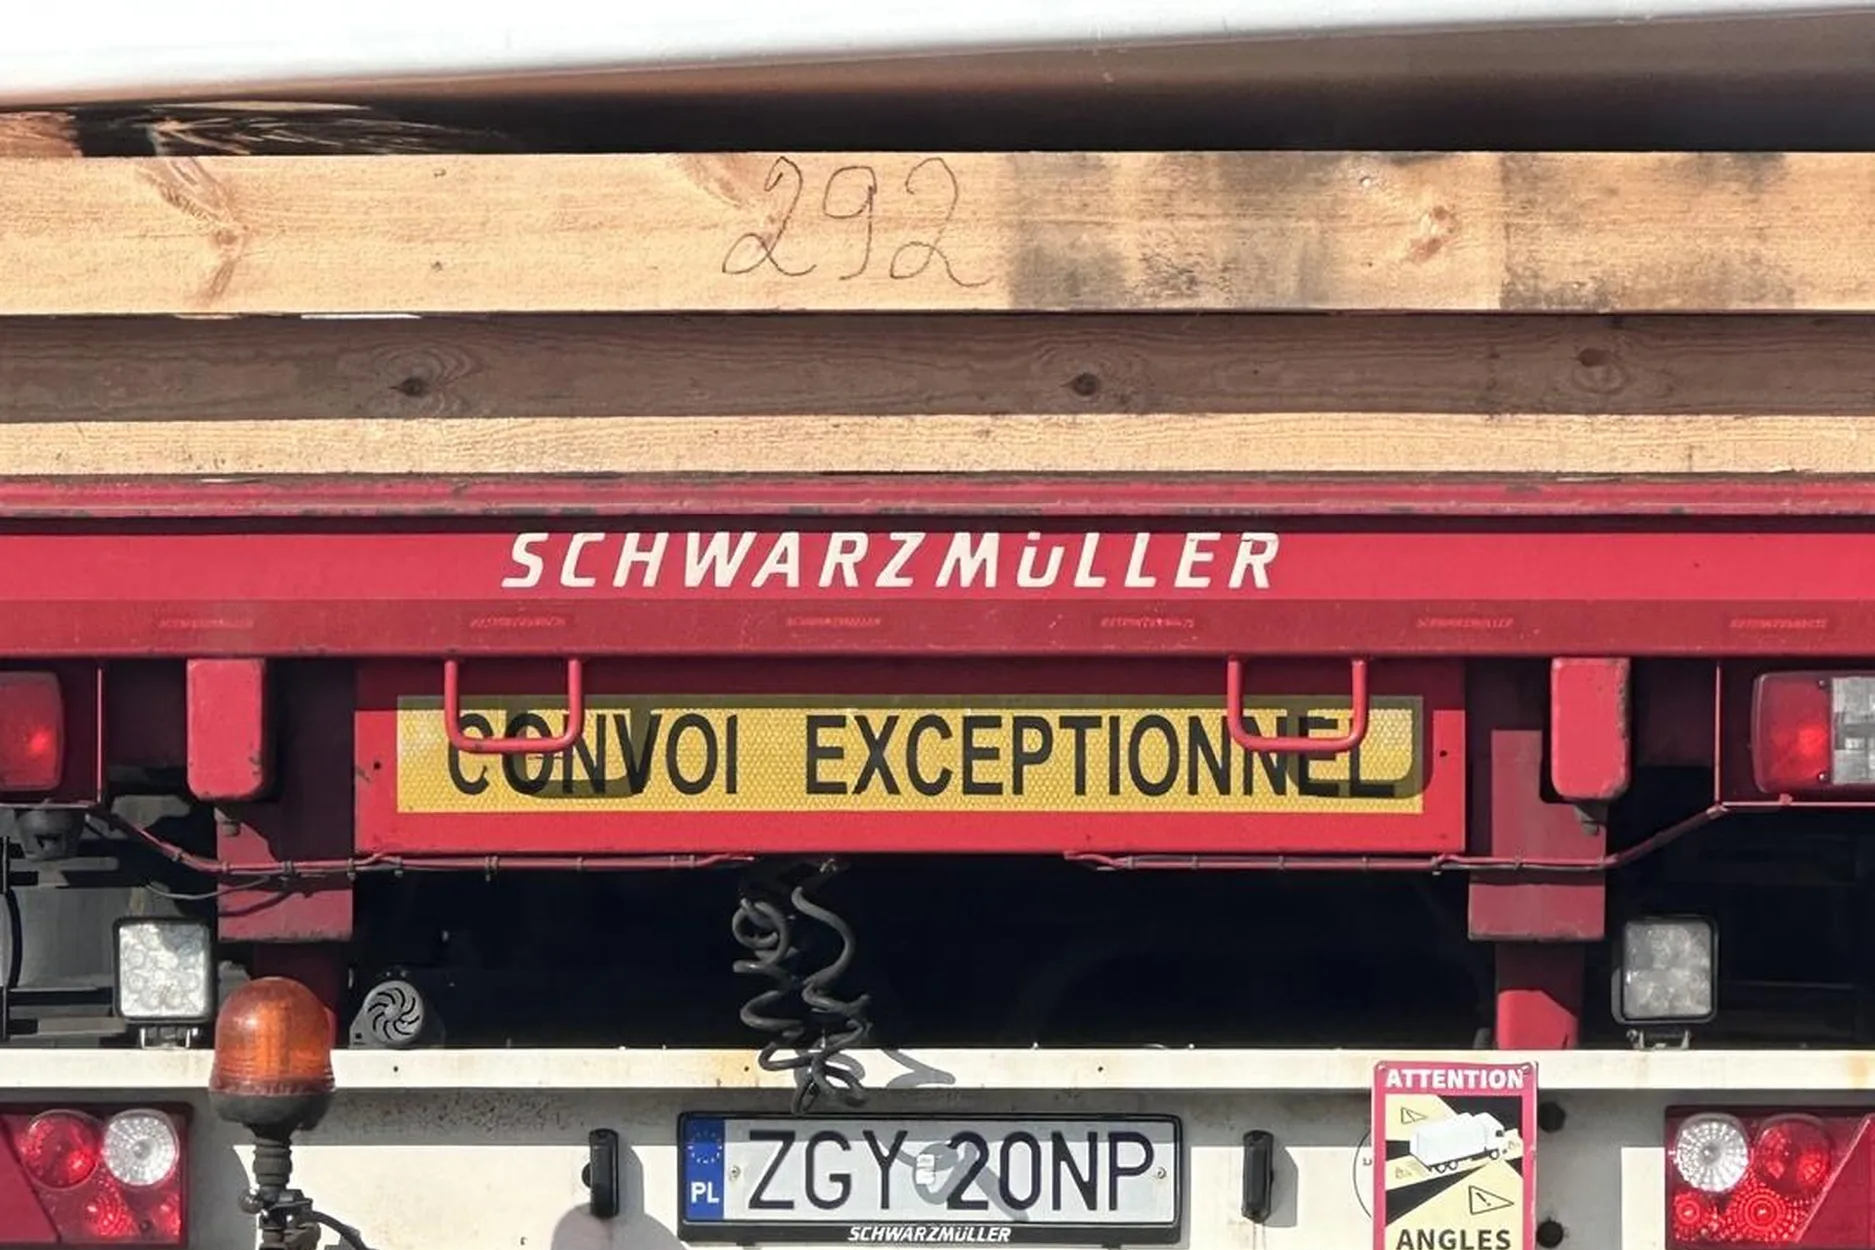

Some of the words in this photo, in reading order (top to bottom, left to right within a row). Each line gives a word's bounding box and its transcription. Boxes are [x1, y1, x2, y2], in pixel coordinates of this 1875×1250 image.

[722, 155, 994, 287] 292
[448, 712, 738, 797] CONVOI
[806, 713, 1395, 798] EXCEPTIONNEL
[1385, 1068, 1524, 1090] ATTENTION
[690, 1181, 720, 1204] PL
[748, 1129, 909, 1211] ZGY
[946, 1129, 1155, 1211] 20NP
[1396, 1229, 1511, 1250] ANGLES
